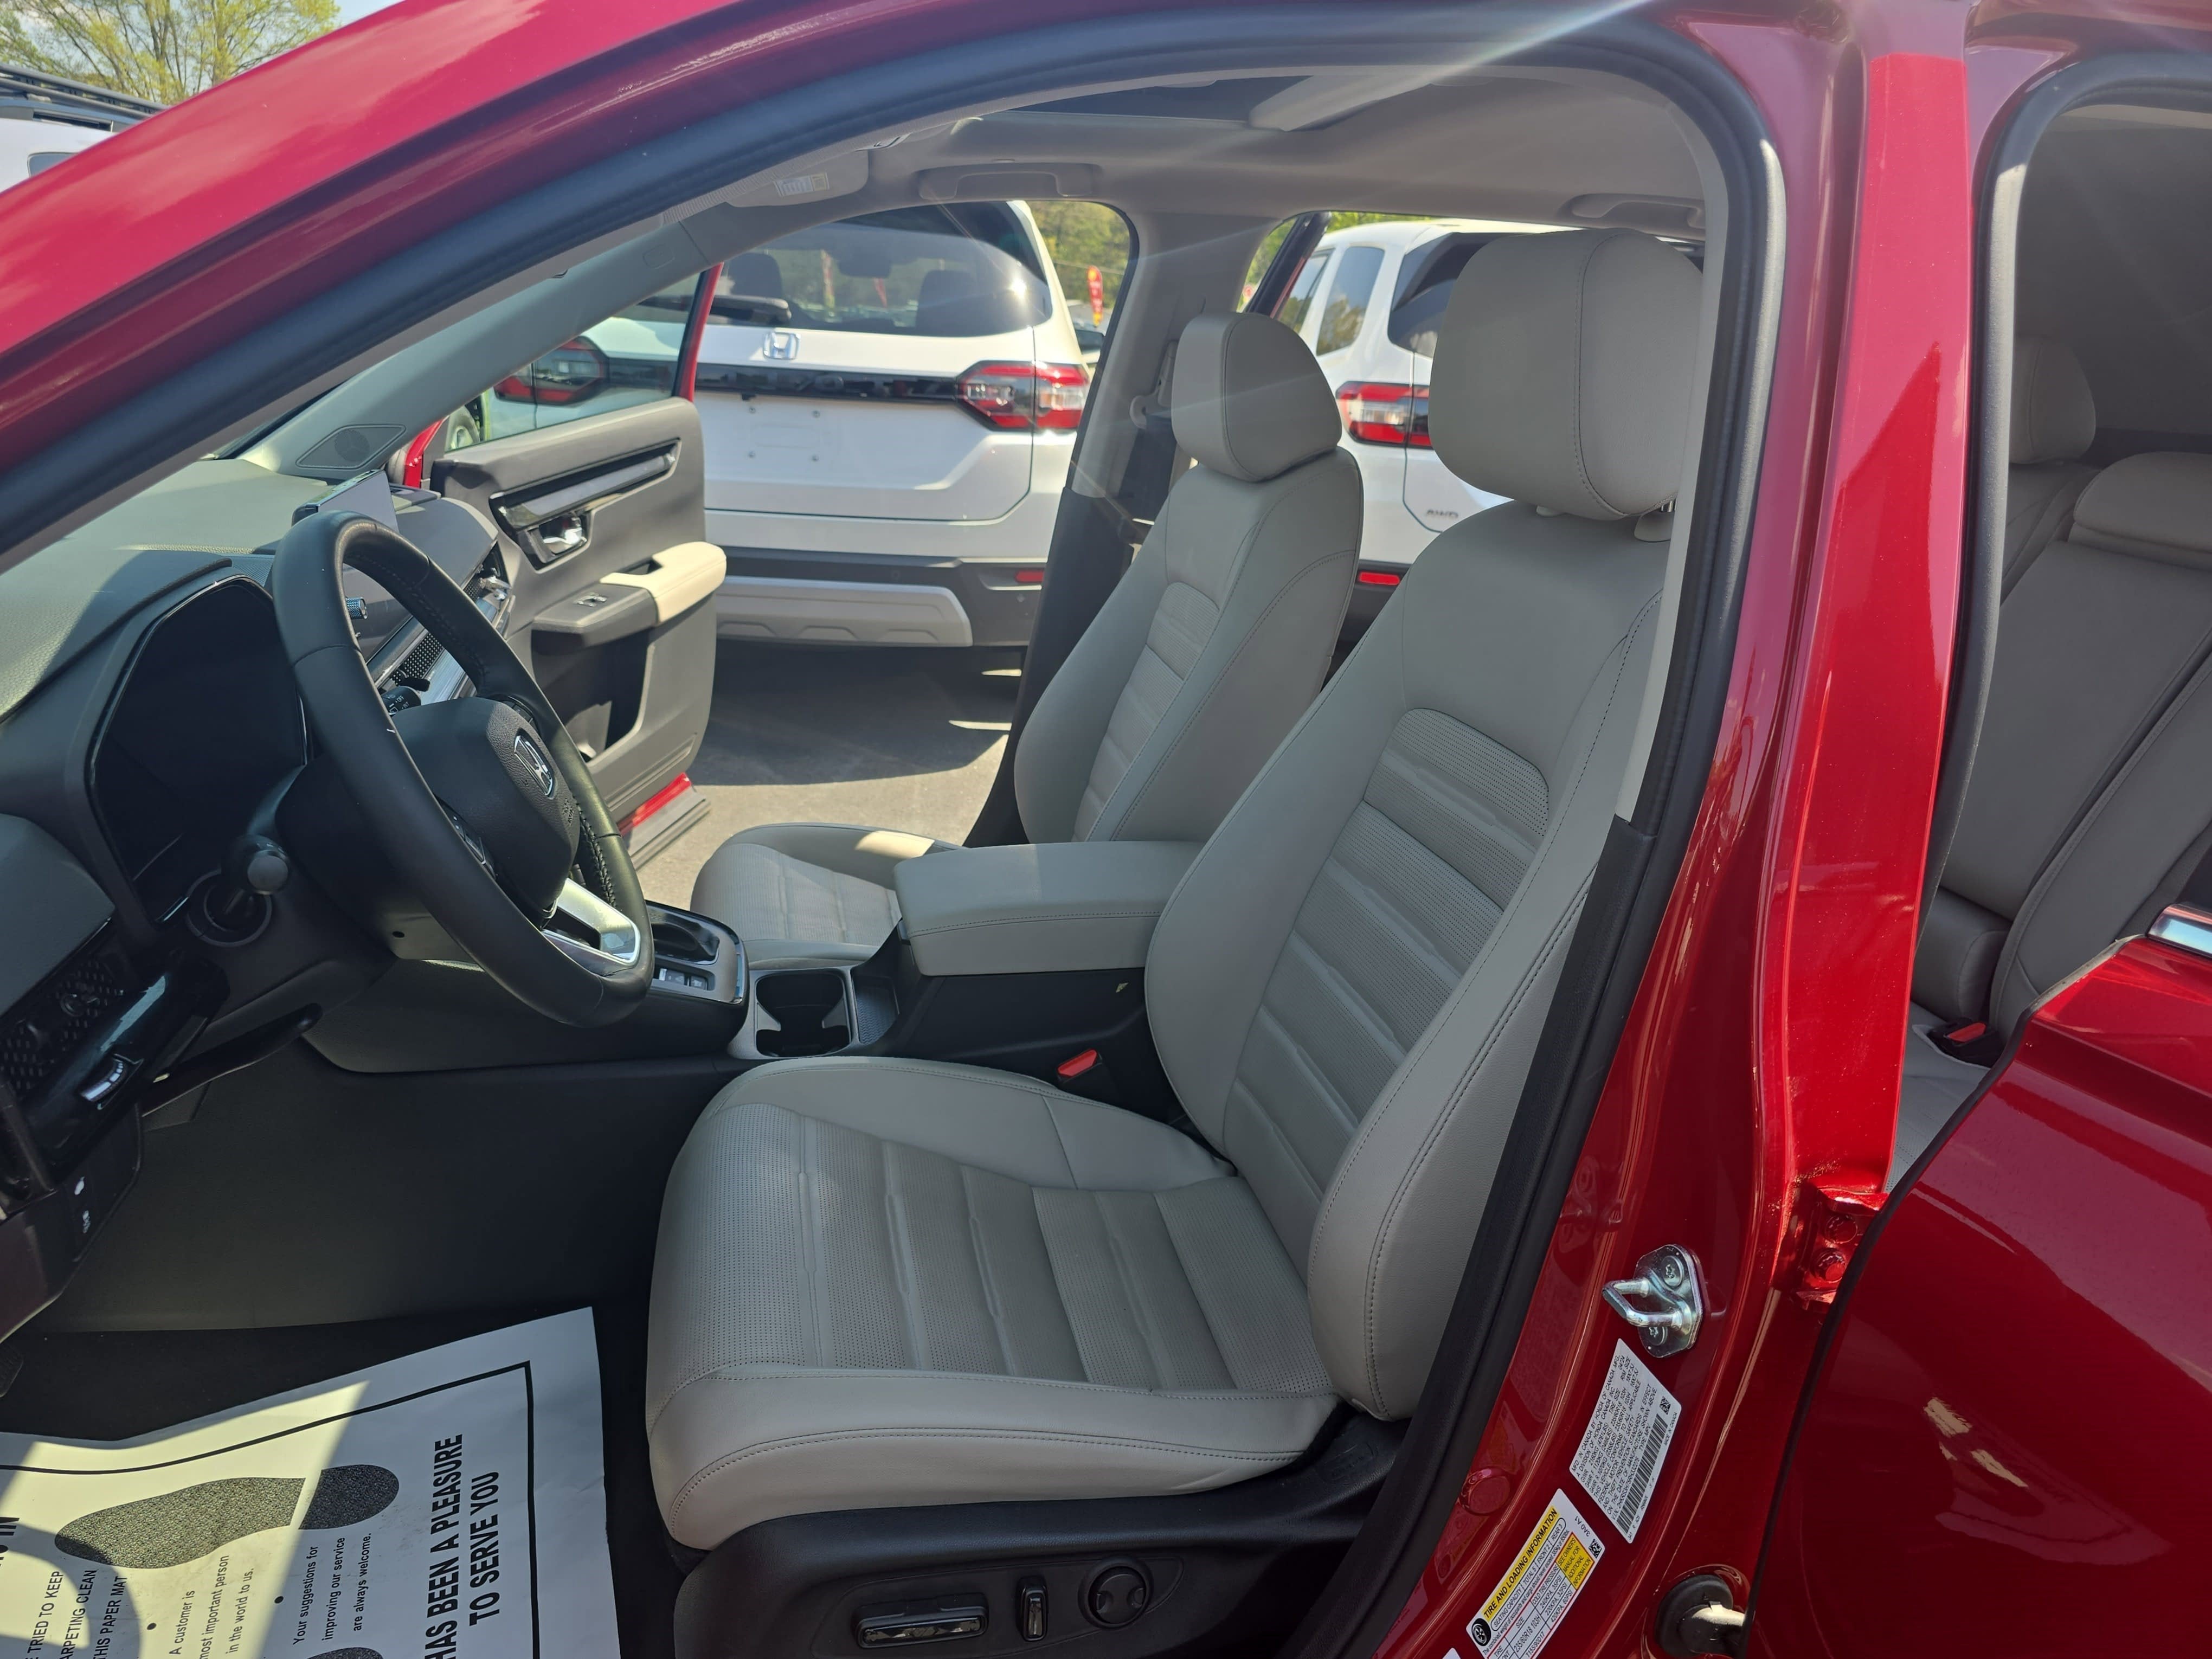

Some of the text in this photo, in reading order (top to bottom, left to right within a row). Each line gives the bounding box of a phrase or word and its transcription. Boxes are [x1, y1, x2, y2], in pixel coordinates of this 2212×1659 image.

[1579, 1449, 1591, 1471] DIVISION
[1589, 1439, 1594, 1449] OF
[1593, 1421, 1603, 1439] HONDA
[1601, 1399, 1611, 1420] CANADA
[1581, 1430, 1593, 1451] CANADA
[1591, 1420, 1596, 1429] BY
[1594, 1401, 1604, 1420] HONDA
[1602, 1391, 1607, 1400] OF
[1605, 1369, 1615, 1391] CANADA
[1593, 1485, 1602, 1498] THIS
[1599, 1462, 1611, 1484] VEHICLE
[1610, 1433, 1623, 1462] CONFORMS
[1621, 1423, 1626, 1432] TO
[1628, 1379, 1641, 1411] APPLICABLE
[1608, 1478, 1617, 1496] THEFT
[1616, 1446, 1630, 1478] PREVENTION
[1629, 1413, 1642, 1445] STANDARDS
[1642, 1384, 1651, 1405] EFFECT
[1598, 1415, 1635, 1504] FEDERAL MOTOR VEHICLE SAFETY
[1607, 1505, 1613, 1515] ON
[1616, 1477, 1625, 1493] DATE
[1623, 1468, 1628, 1477] OF
[1627, 1429, 1643, 1468] MANUFACTURE
[1641, 1409, 1650, 1429] SHOWN
[353, 1533, 371, 1631] are always welcome.
[425, 1434, 462, 1659] HAS BEEN A PLEASURE
[470, 1471, 500, 1626] TO SERVE YOU
[1484, 1509, 1557, 1618] TIRE AND LOADING INFORMATION
[1494, 1607, 1508, 1627] SEATING
[1507, 1587, 1522, 1609] CAPACITY
[1523, 1571, 1534, 1585] TOTAL
[1537, 1548, 1548, 1564] FRONT
[1551, 1527, 1560, 1540] REAR
[1563, 1546, 1580, 1572] MANUAL FOR
[1568, 1555, 1584, 1579] ADDITIONAL
[1573, 1558, 1591, 1586] INFORMATION
[38, 1603, 54, 1617] TO
[44, 1571, 63, 1598] KEEP
[76, 1570, 97, 1603] CLEAN
[99, 1599, 121, 1634] PAPER
[110, 1576, 127, 1596] MAT
[182, 1591, 195, 1599] is
[200, 1555, 229, 1659] most important person
[226, 1568, 254, 1654] in the world to us.
[292, 1547, 318, 1644] Your suggestions for
[322, 1538, 345, 1641] improving our service
[1532, 1565, 1559, 1605] COLD TIRE PRESSURE
[27, 1621, 49, 1653] TRIED
[174, 1602, 192, 1643] customer
[1494, 1645, 1503, 1657] TIRE
[1514, 1614, 1541, 1652] 235/60R18 103H
[1516, 1616, 1525, 1629] SIZE
